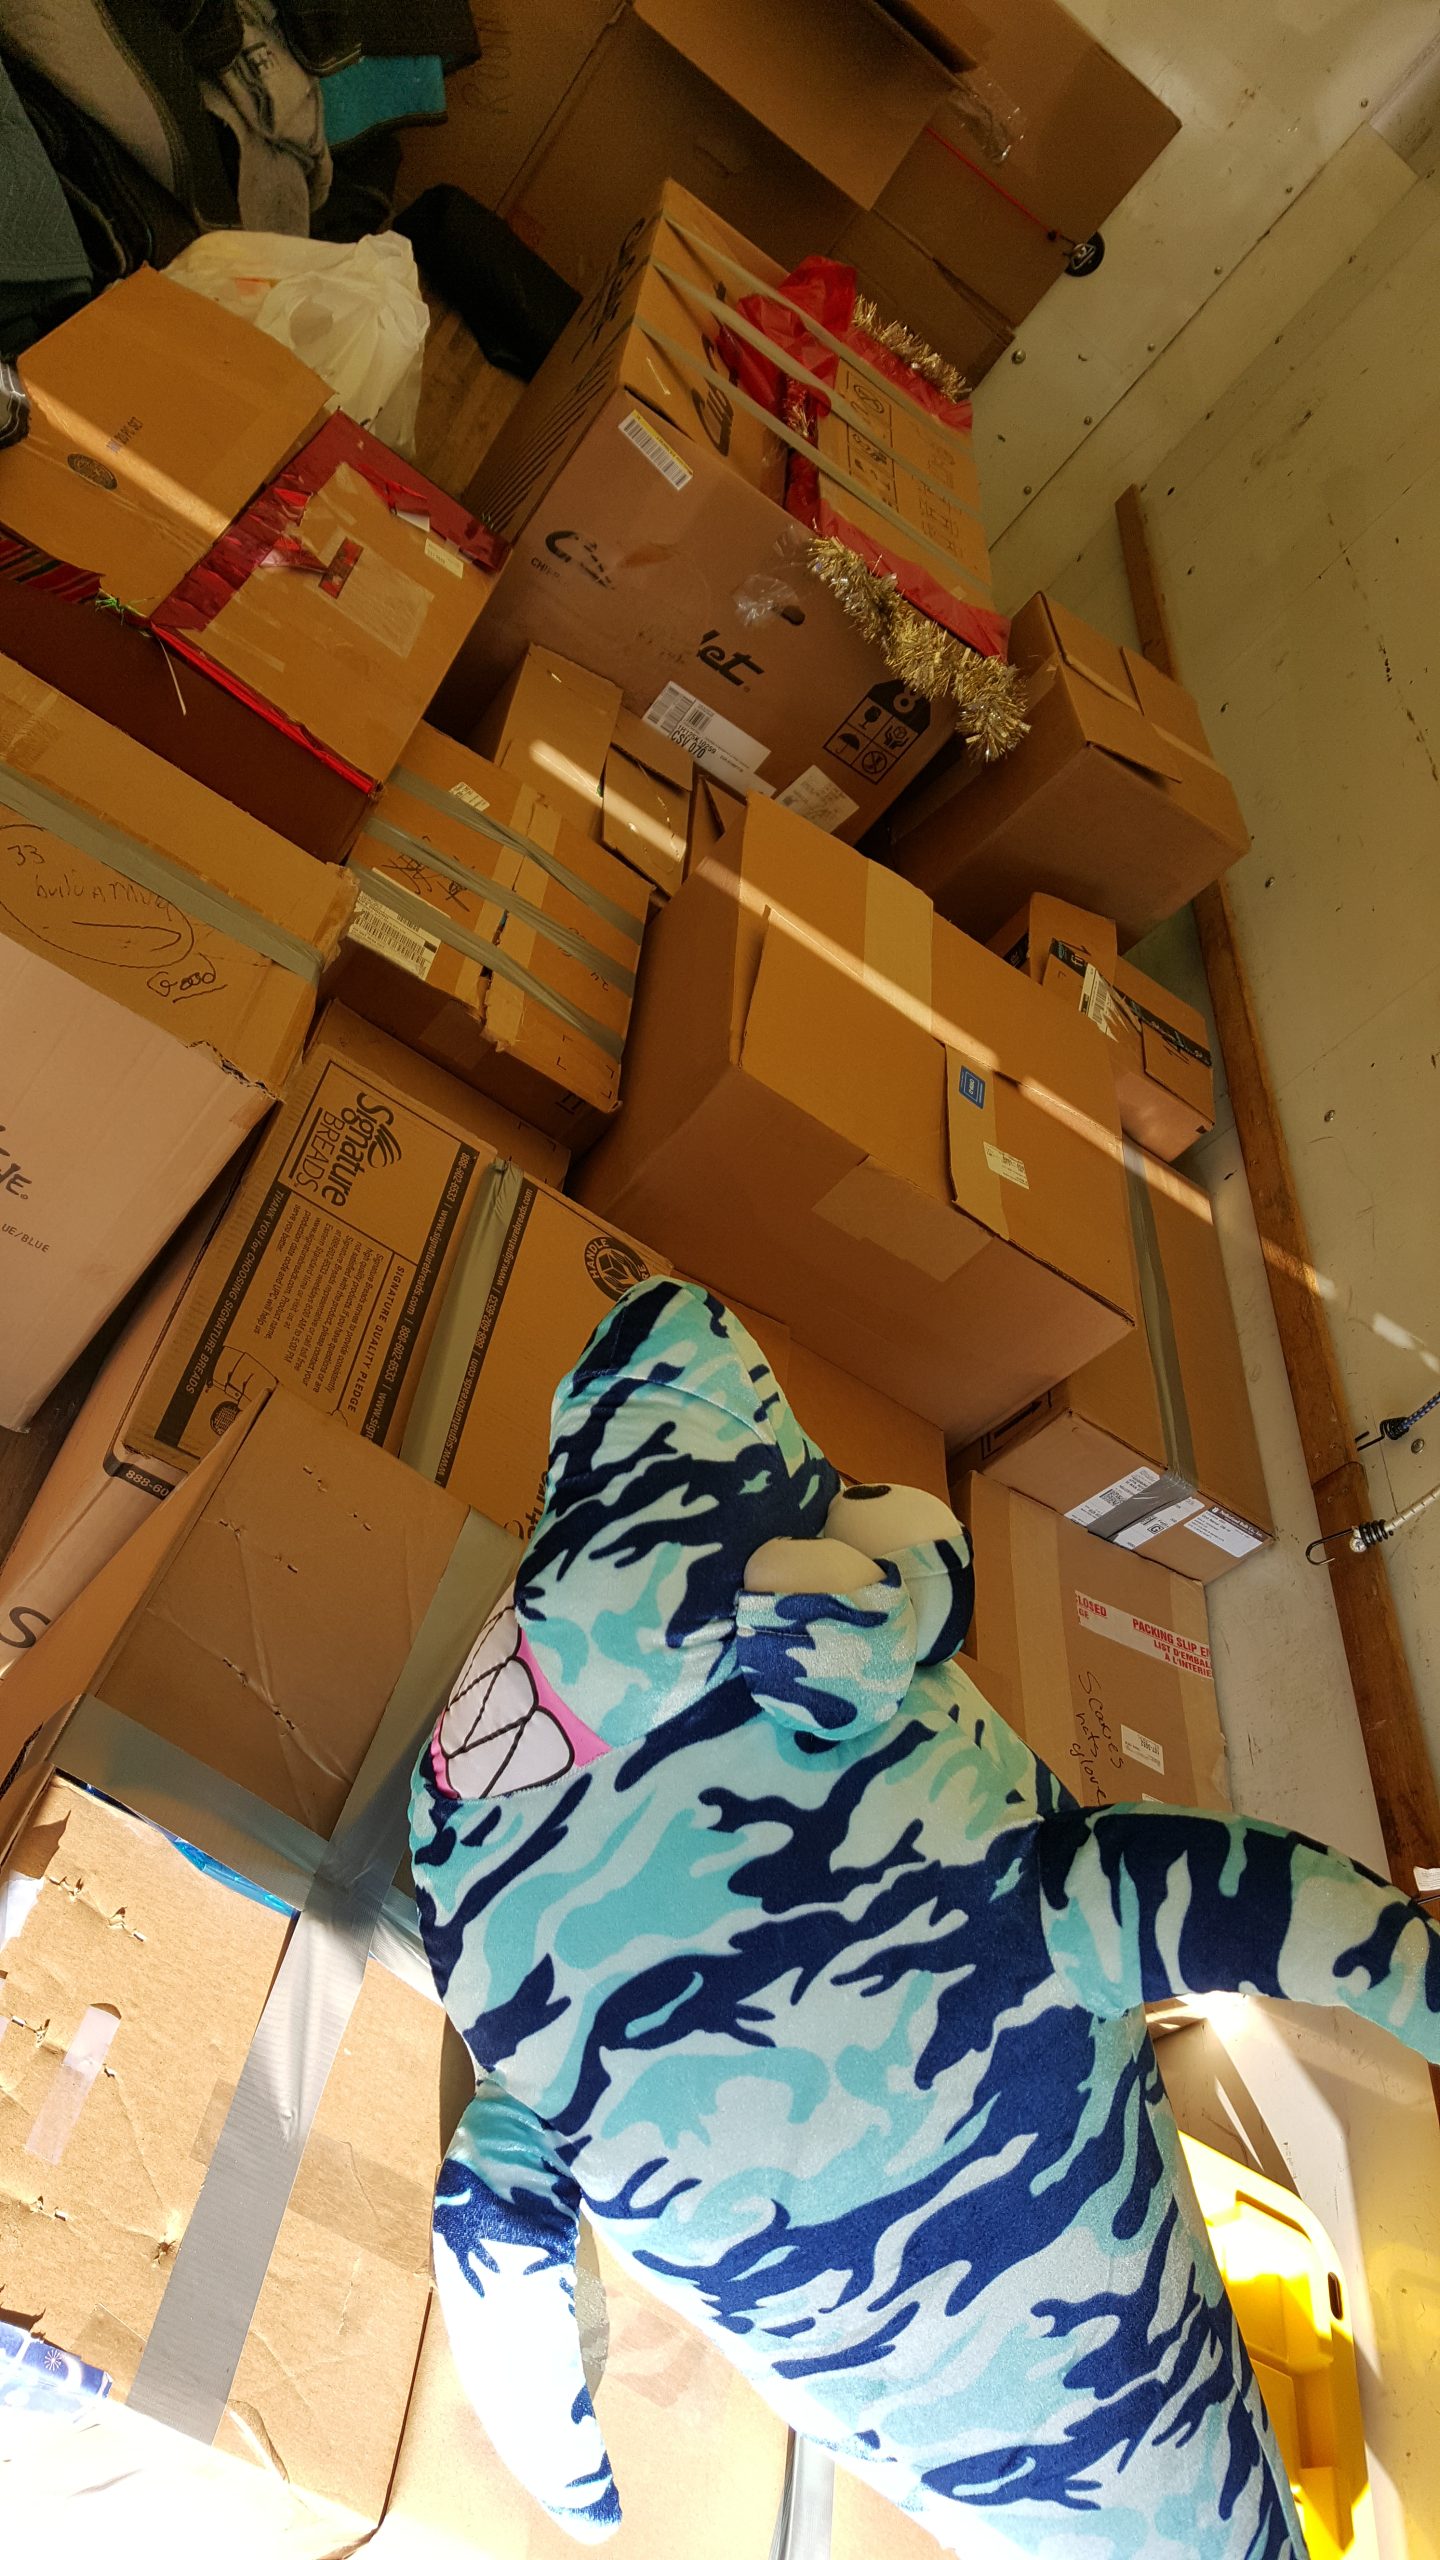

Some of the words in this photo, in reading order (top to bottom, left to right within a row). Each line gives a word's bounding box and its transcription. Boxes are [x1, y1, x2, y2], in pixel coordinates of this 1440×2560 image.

[670, 730, 690, 748] CSV
[688, 742, 706, 758] 070
[296, 1110, 345, 1192] BREADS
[322, 1093, 393, 1206] Signature
[447, 1153, 470, 1201] 888-602-6533
[266, 1190, 283, 1218] THANK
[251, 1238, 261, 1252] for
[257, 1220, 270, 1239] YOU
[229, 1252, 254, 1299] CHOOSING
[367, 1253, 383, 1282] Signature
[407, 1210, 448, 1314] www.signaturebreads.com
[587, 1238, 610, 1279] HANDLE
[311, 1284, 332, 1327] representative
[359, 1282, 373, 1303] Breads
[379, 1266, 404, 1322] SIGNATURE
[204, 1300, 233, 1353] SIGNATURE
[331, 1327, 343, 1343] have
[340, 1330, 353, 1355] provide
[363, 1325, 383, 1369] QUALITY
[434, 1359, 477, 1475] www.signaturebreads.com
[473, 1295, 498, 1348] 888-602-6533
[497, 1189, 532, 1285] www.signaturebreads.com
[186, 1353, 208, 1393] BREADS
[320, 1343, 335, 1373] questions
[325, 1355, 344, 1393] consistently
[385, 1325, 409, 1382] 888-602-6533
[348, 1371, 367, 1412] PLEDGE
[1077, 1595, 1106, 1617] LOSED
[1133, 1618, 1173, 1643] PACKING
[1175, 1637, 1197, 1652] SLIP
[1154, 1640, 1170, 1652] LIST
